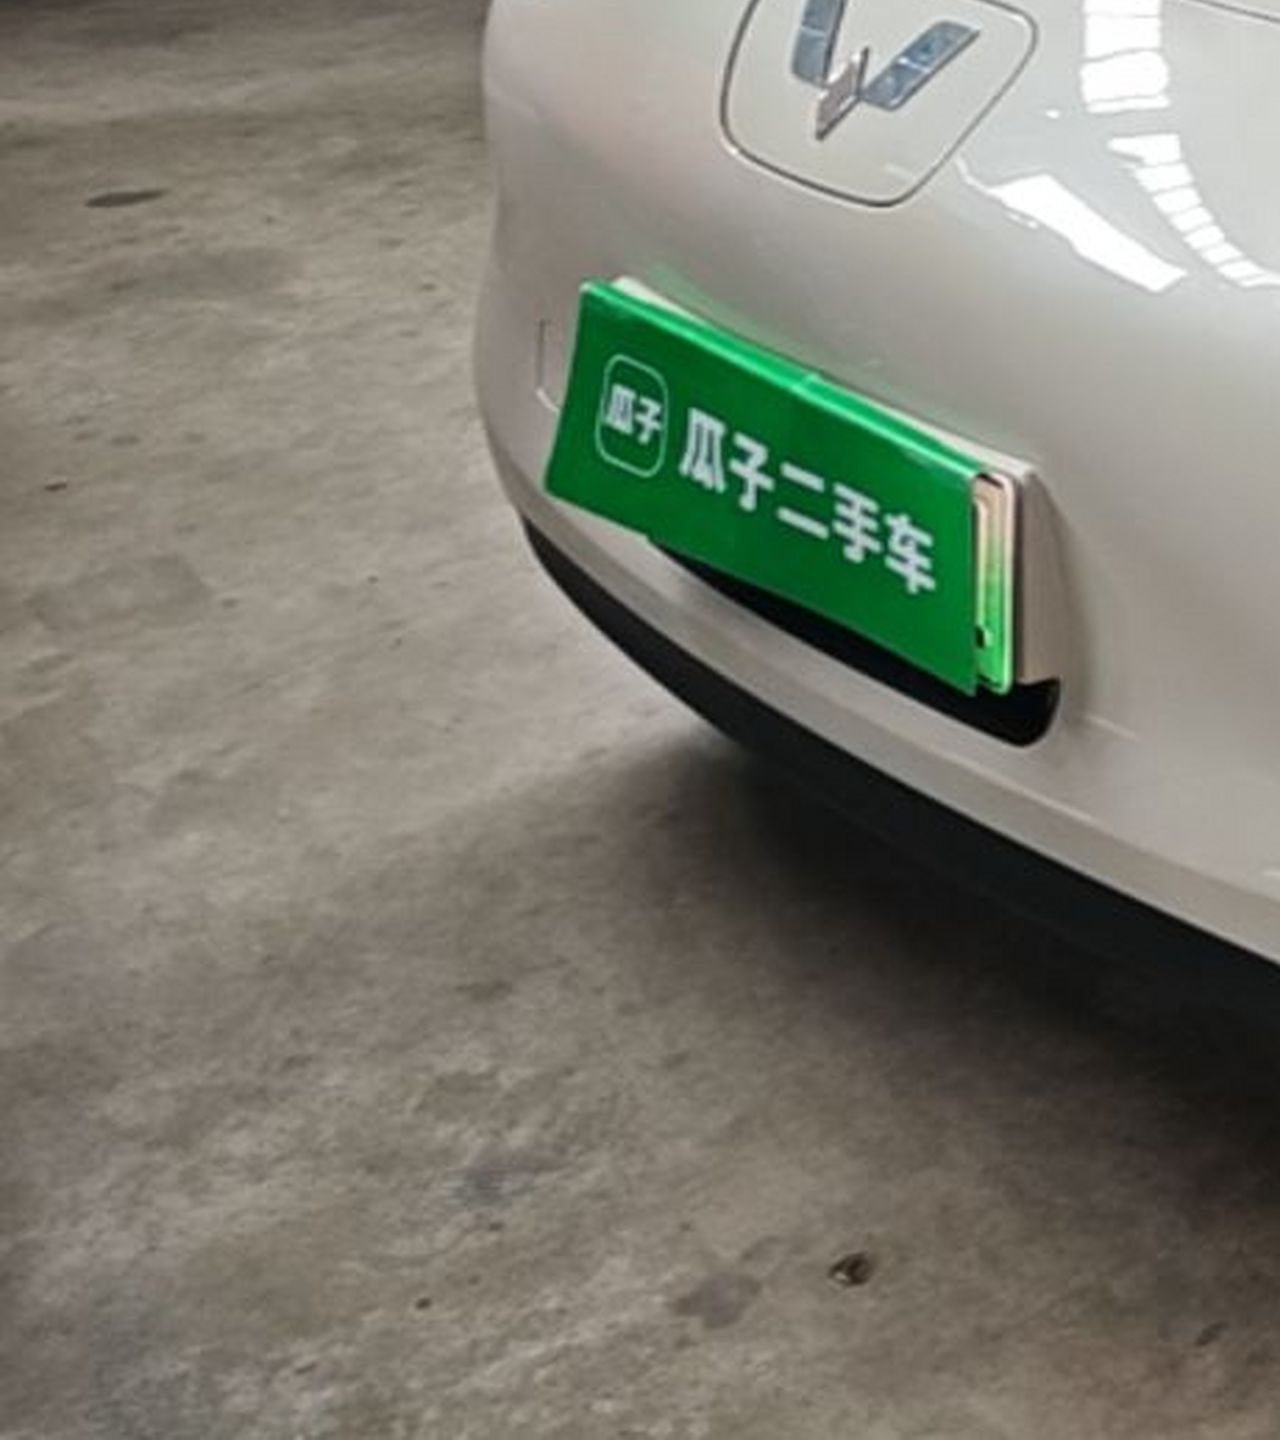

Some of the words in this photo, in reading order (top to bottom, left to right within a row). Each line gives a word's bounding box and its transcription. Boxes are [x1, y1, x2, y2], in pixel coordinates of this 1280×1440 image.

[604, 384, 663, 445] 瓜子
[678, 407, 936, 594] 瓜子二手车
